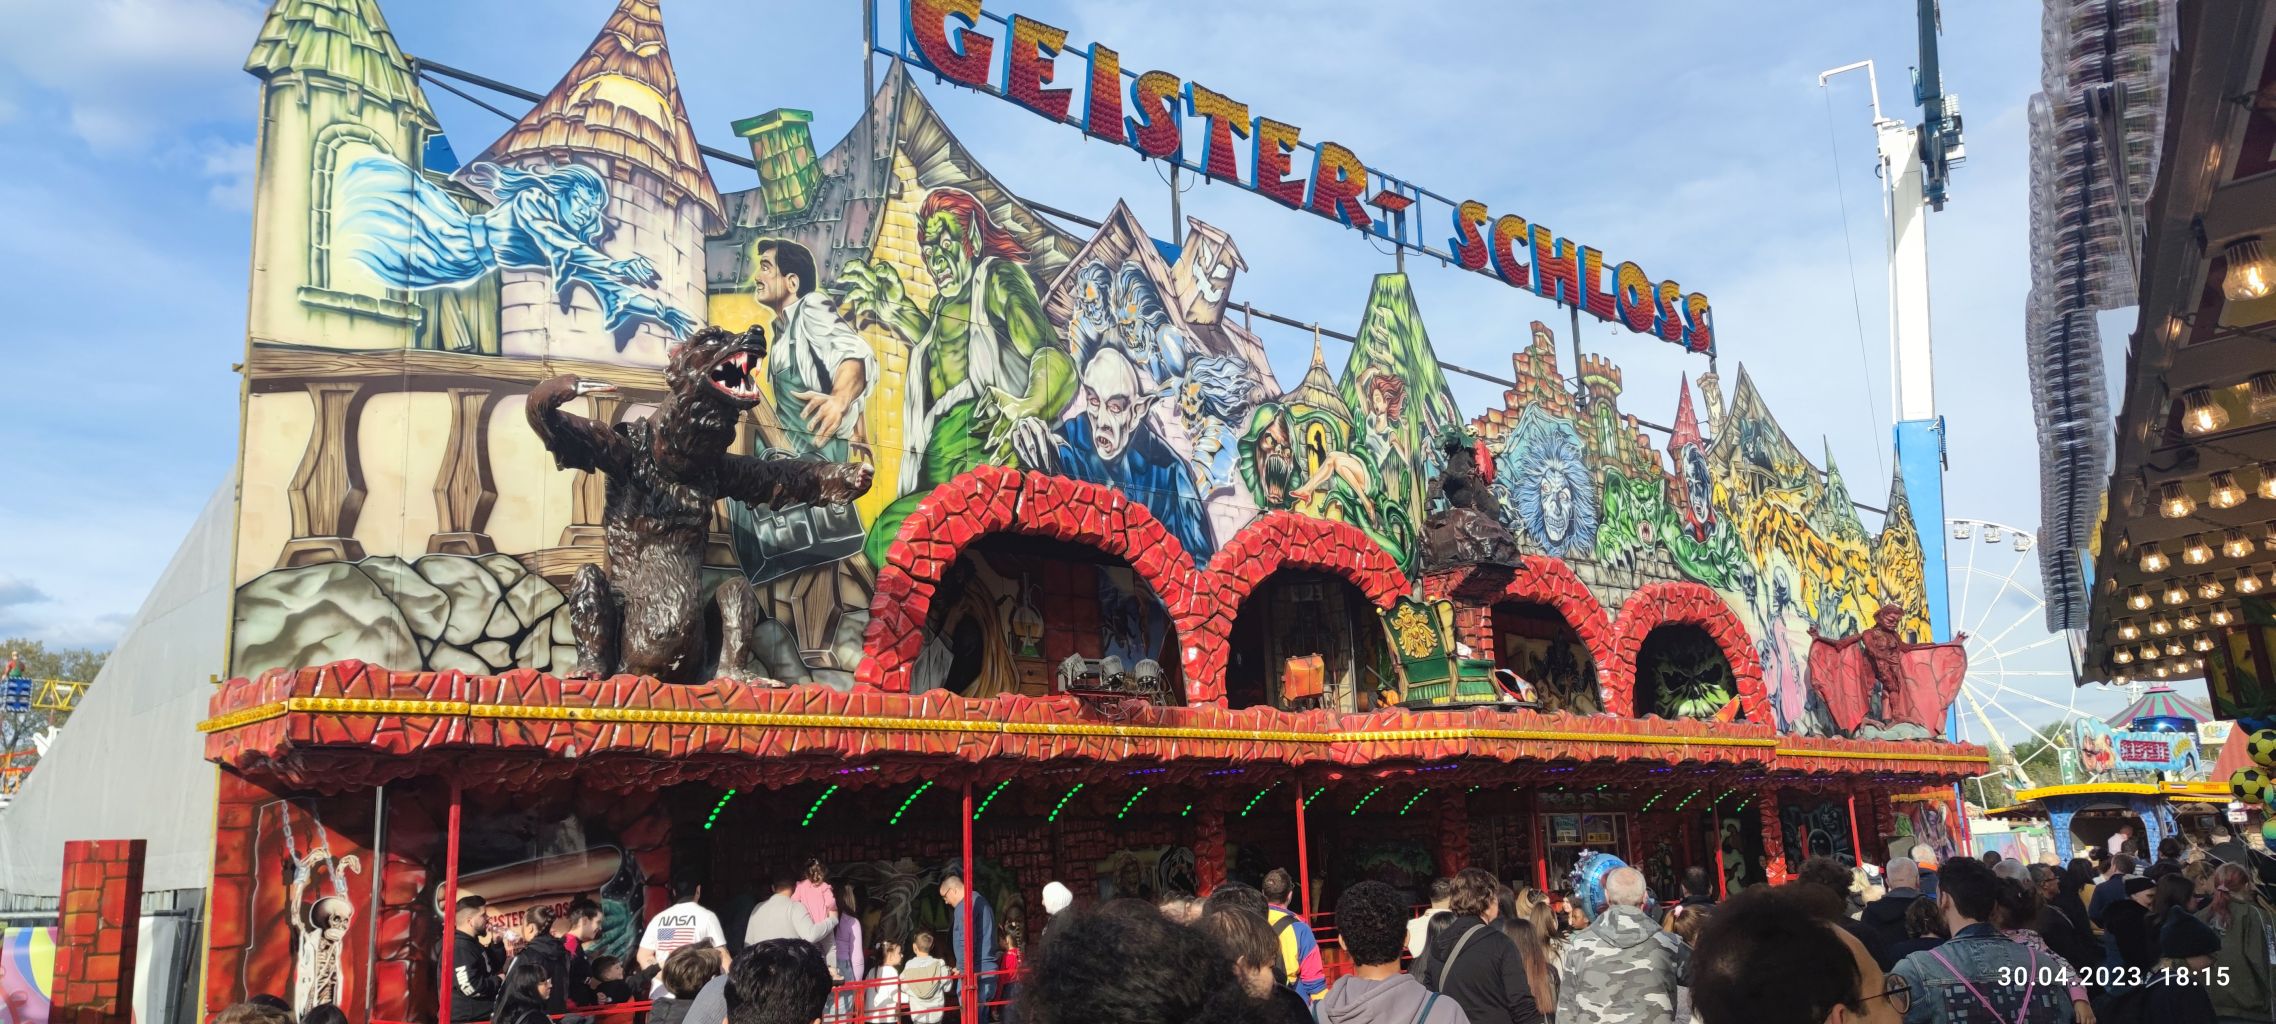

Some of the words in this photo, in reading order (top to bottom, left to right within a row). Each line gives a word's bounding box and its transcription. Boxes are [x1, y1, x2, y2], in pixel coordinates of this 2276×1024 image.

[1449, 200, 1710, 352] SCHLOSS
[658, 915, 696, 927] NASA
[455, 965, 475, 996] NIKE
